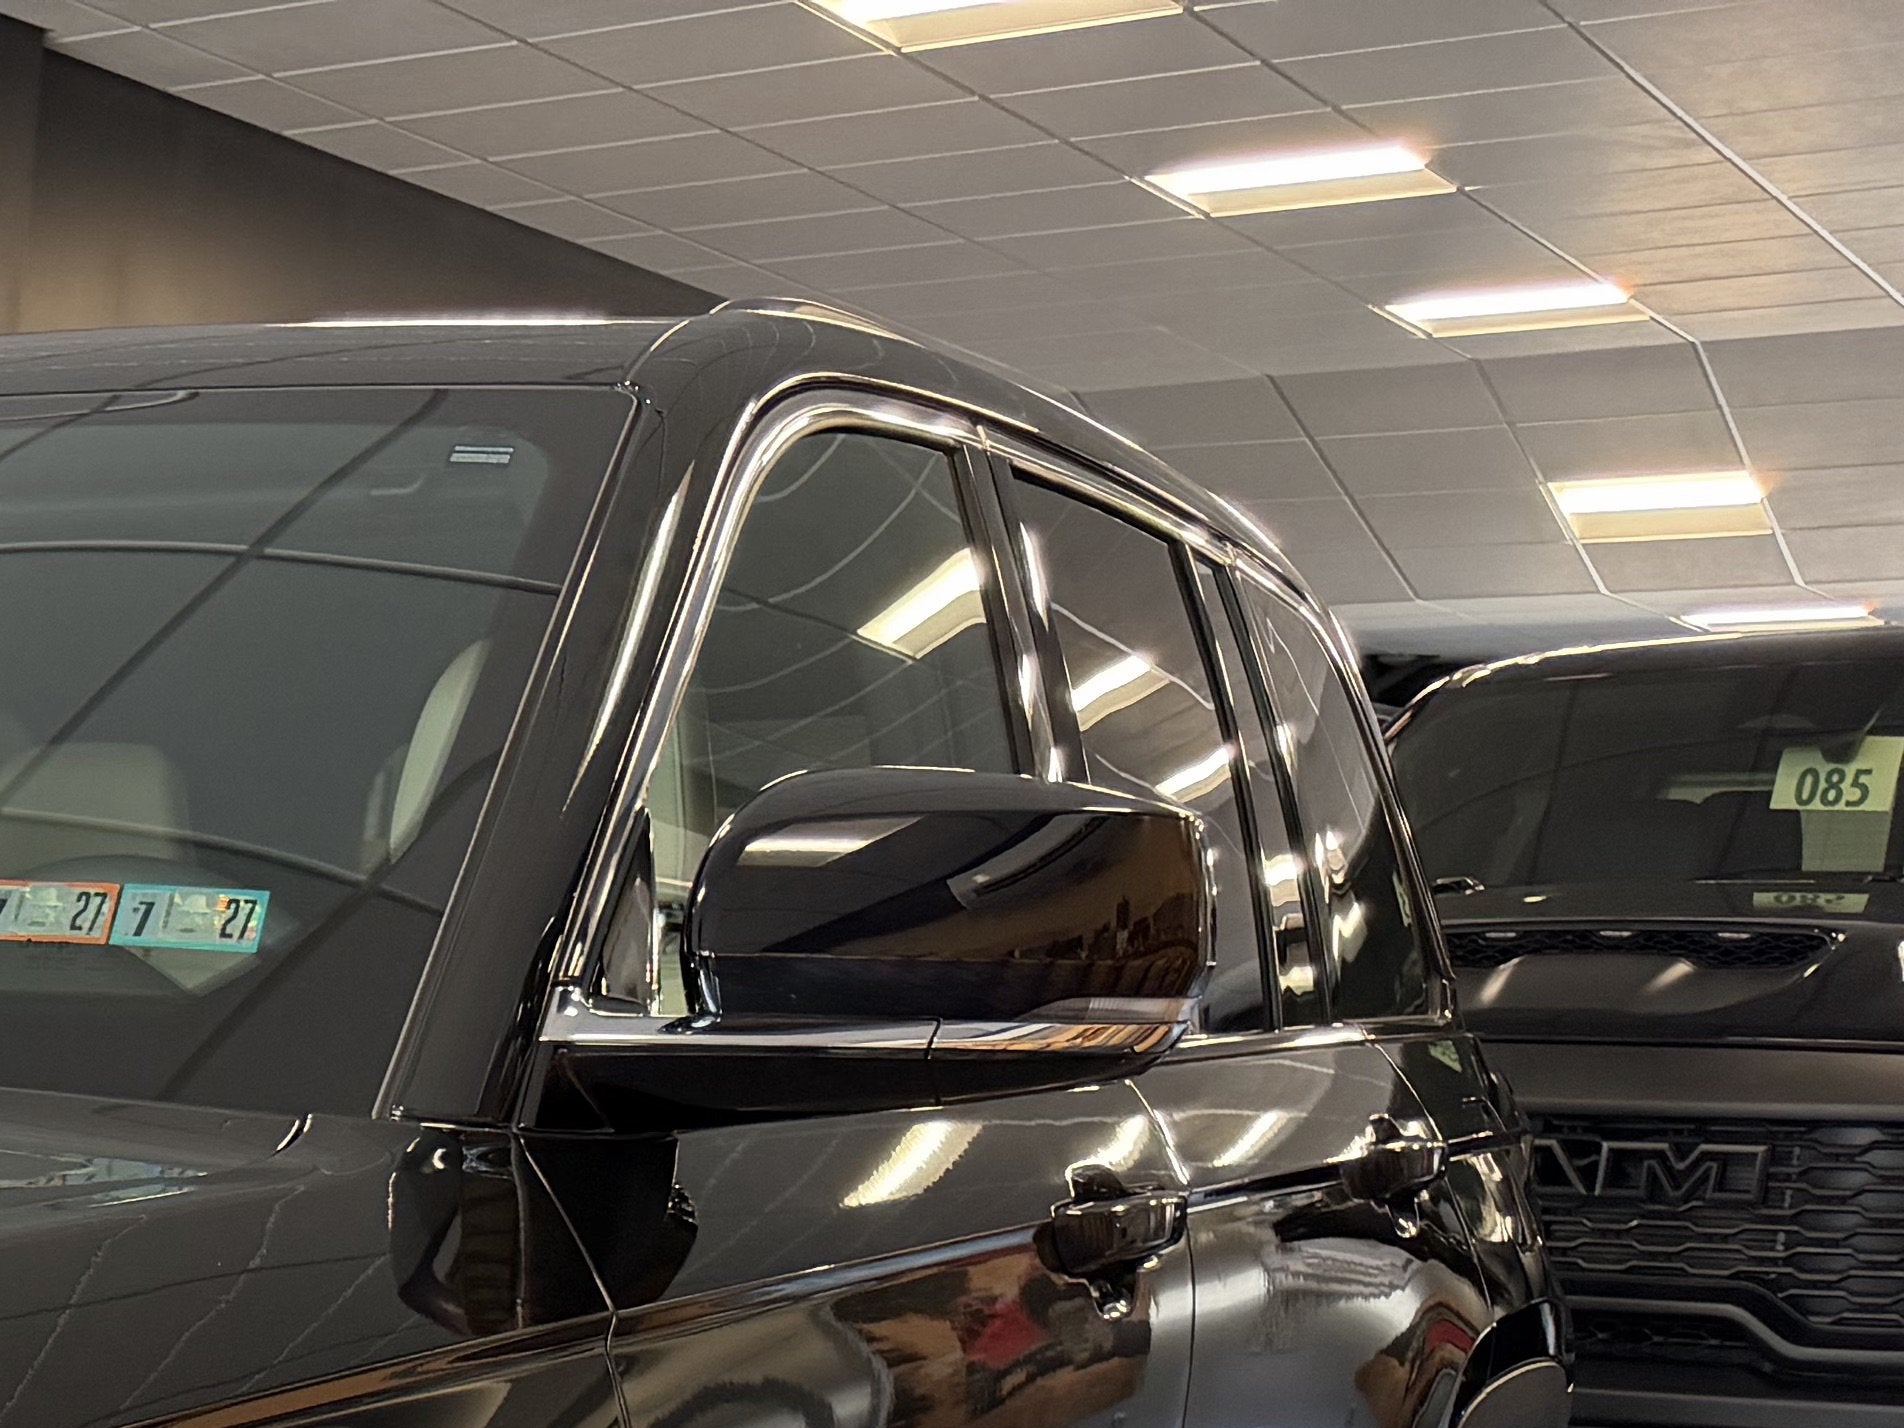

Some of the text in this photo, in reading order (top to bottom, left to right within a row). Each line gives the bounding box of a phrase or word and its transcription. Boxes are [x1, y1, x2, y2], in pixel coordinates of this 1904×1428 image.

[1794, 767, 1874, 807] 085
[69, 891, 108, 934] 27
[131, 897, 258, 941] 7 27
